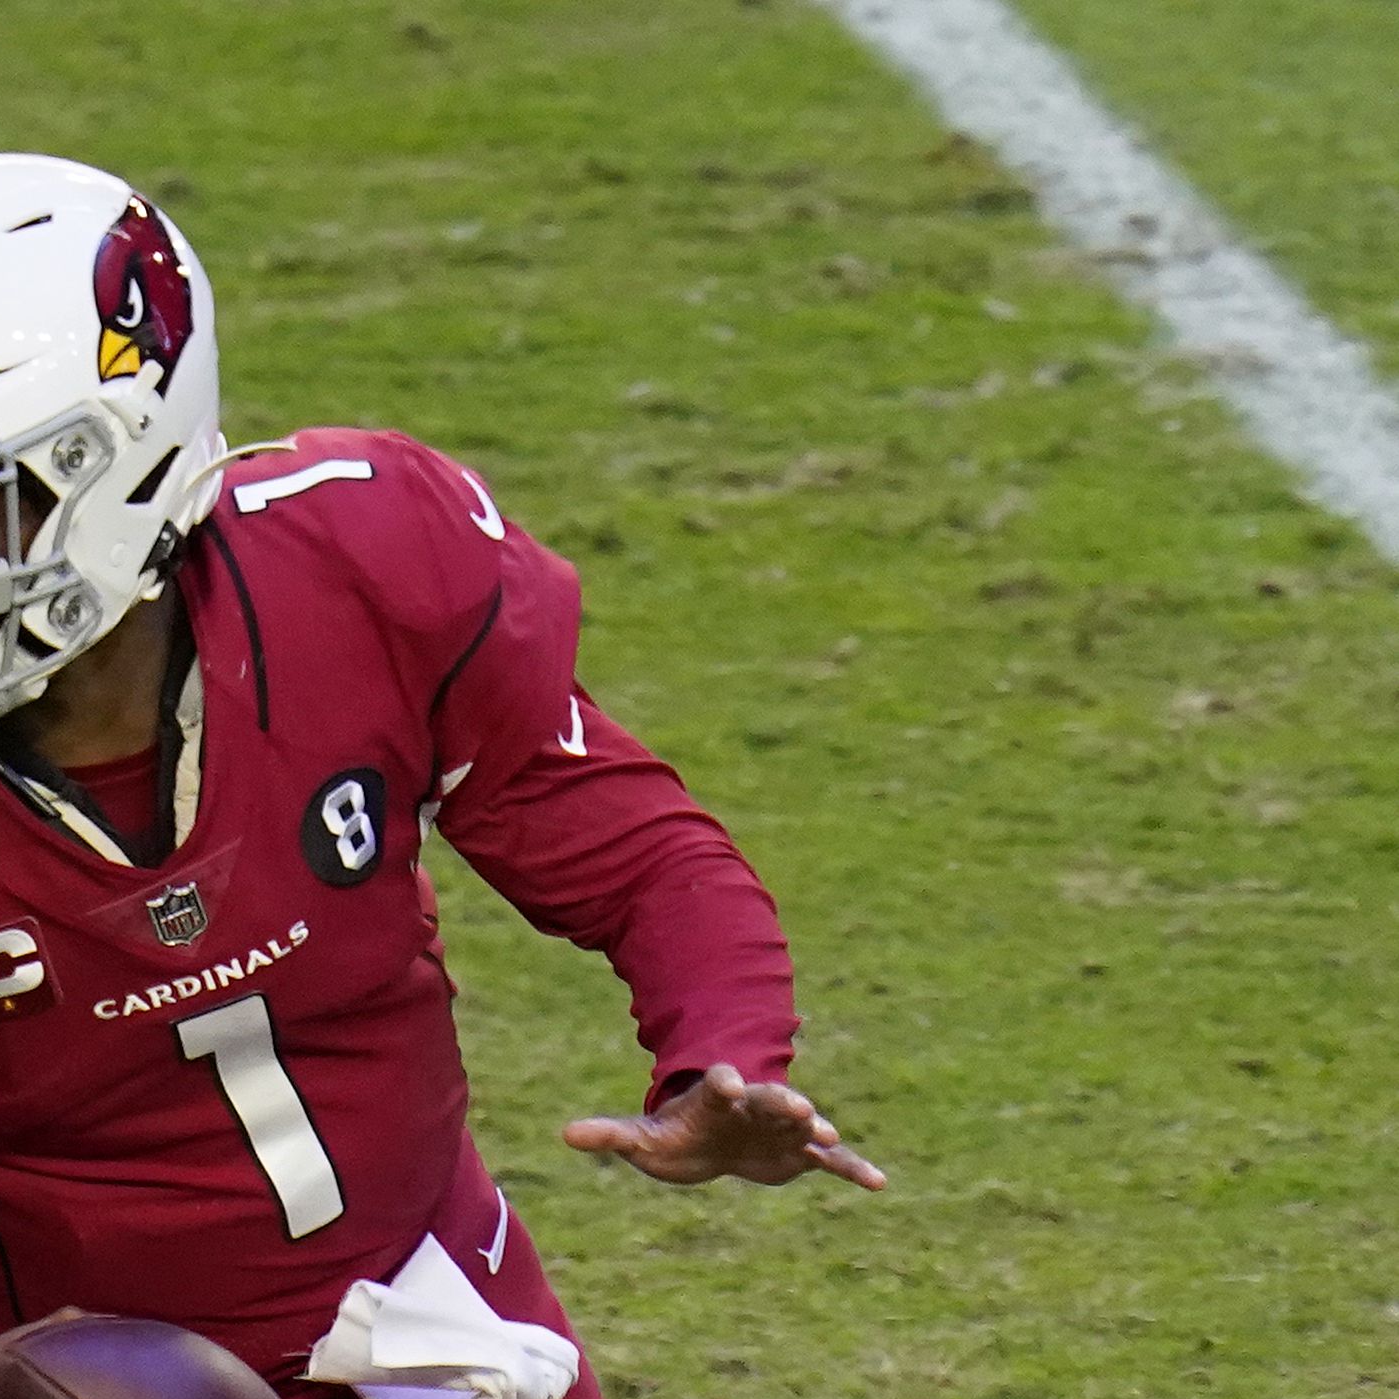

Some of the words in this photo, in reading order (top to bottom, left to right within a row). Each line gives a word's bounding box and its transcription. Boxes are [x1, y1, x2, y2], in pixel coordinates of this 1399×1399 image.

[232, 458, 375, 514] 1
[321, 779, 377, 871] 8
[93, 919, 310, 1020] CARDINALS
[173, 992, 346, 1241] 1
